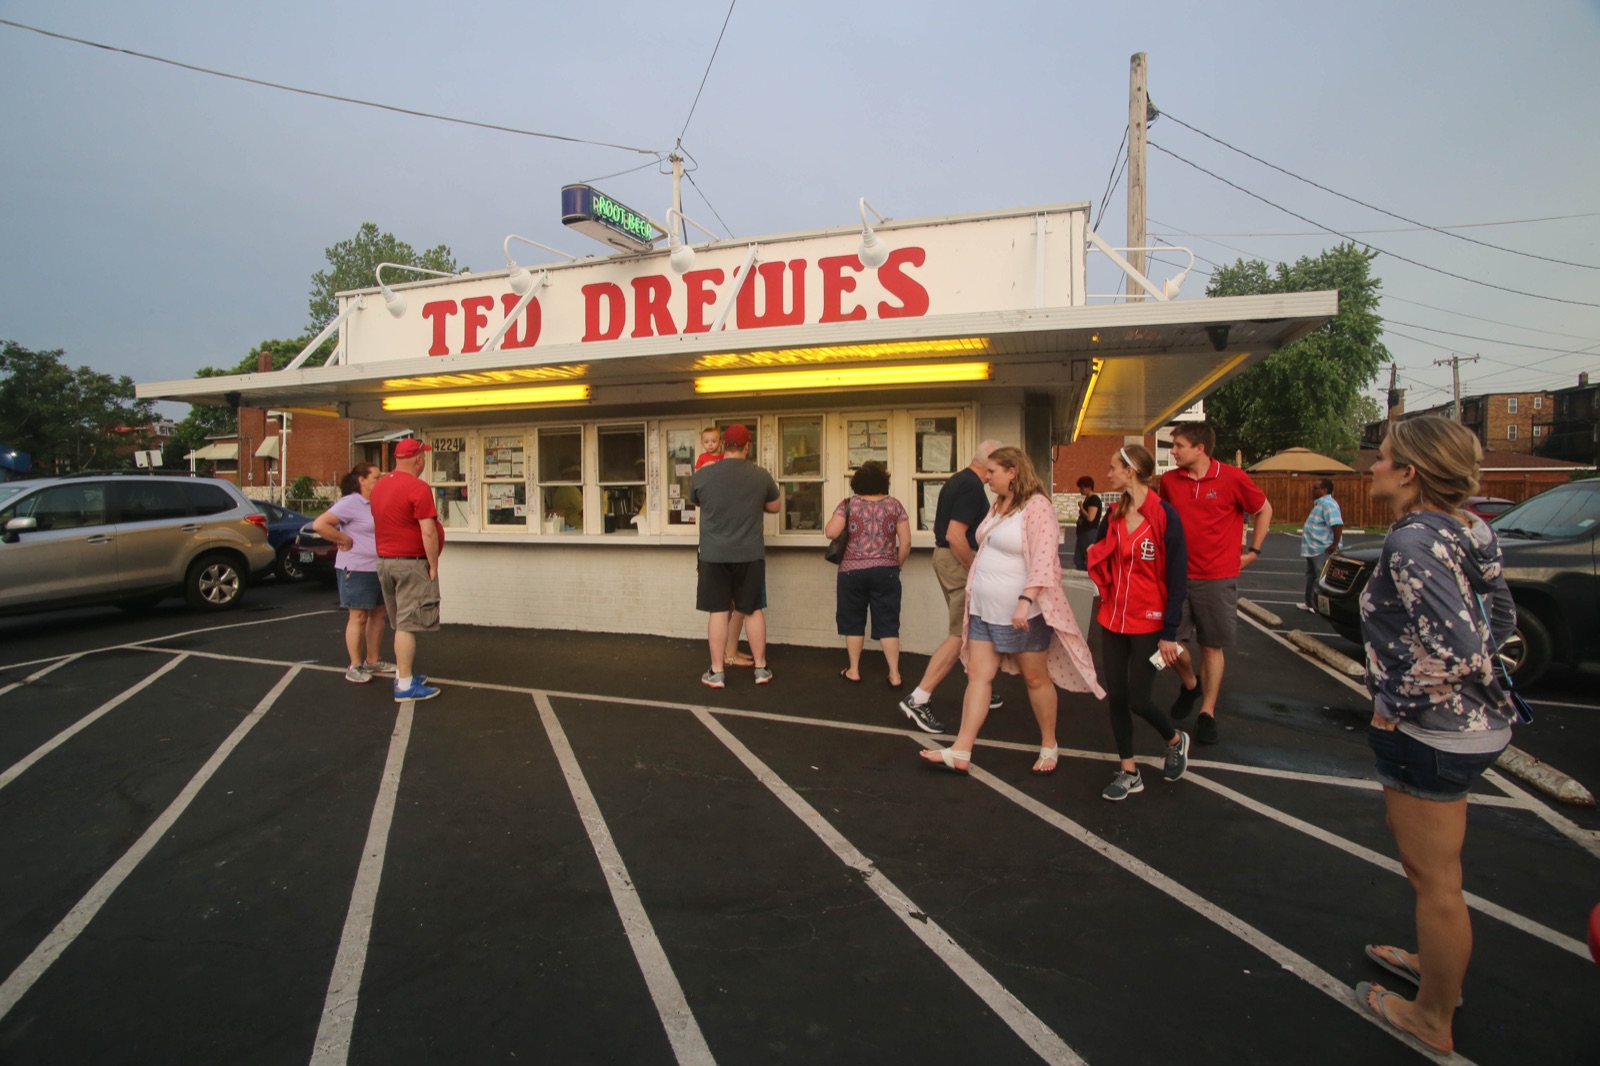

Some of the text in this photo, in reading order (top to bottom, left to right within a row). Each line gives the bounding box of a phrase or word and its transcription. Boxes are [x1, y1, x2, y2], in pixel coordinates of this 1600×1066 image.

[597, 196, 653, 239] ROOT BEER
[422, 246, 929, 356] TED DREWES
[434, 438, 459, 451] 4224
